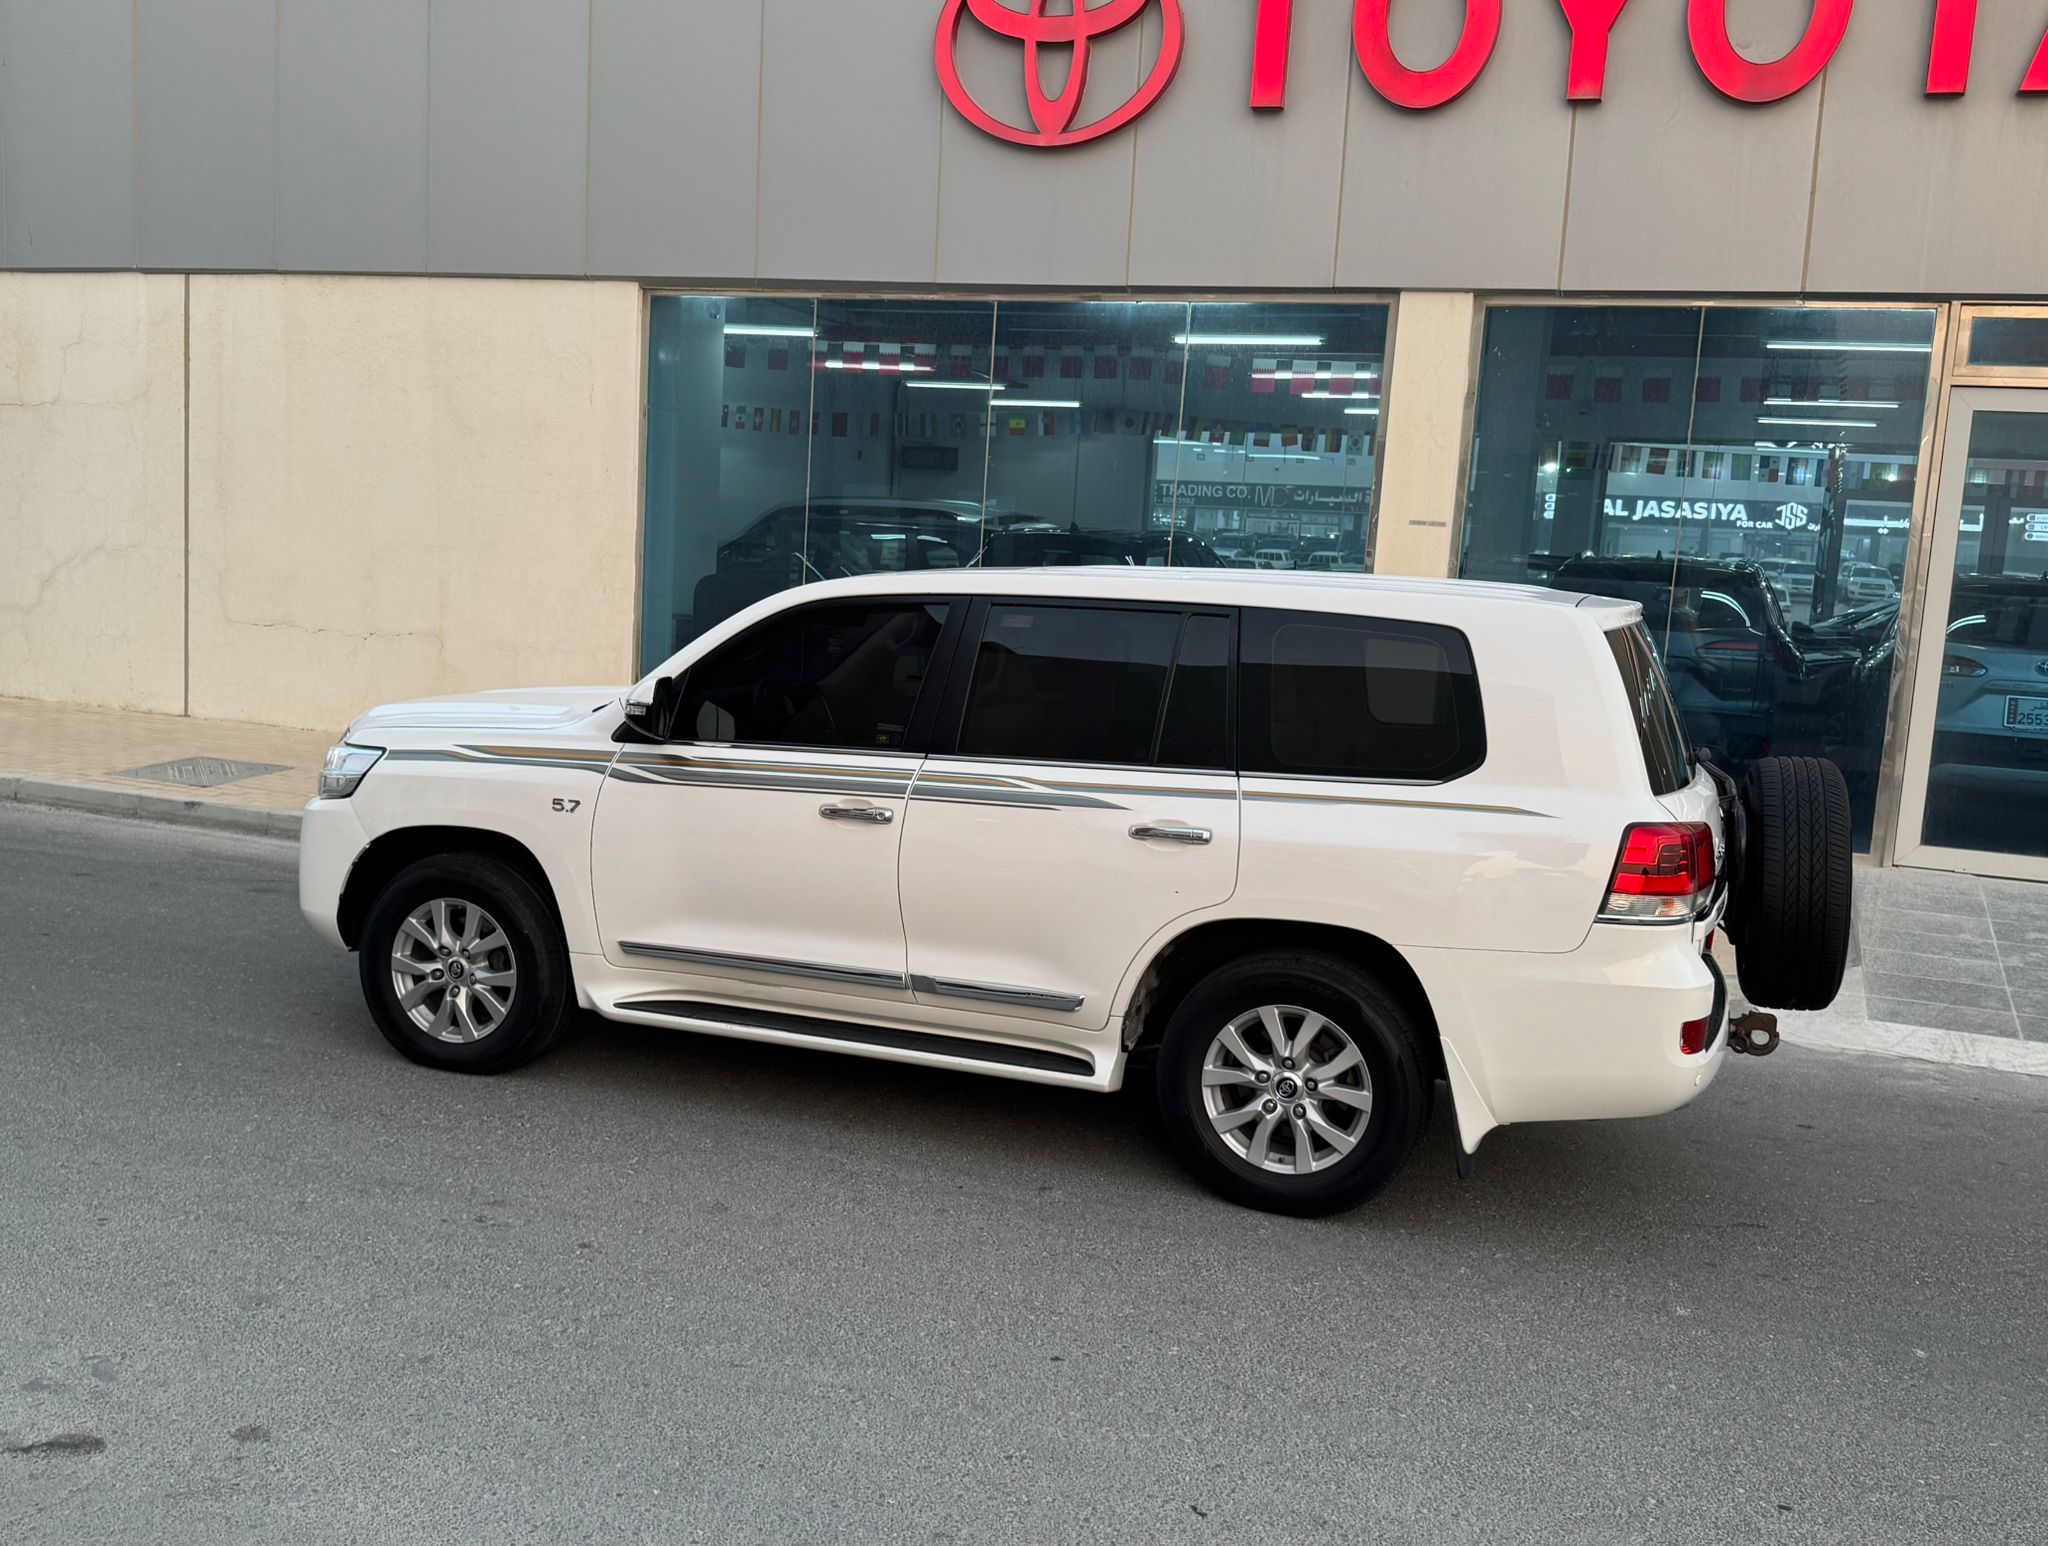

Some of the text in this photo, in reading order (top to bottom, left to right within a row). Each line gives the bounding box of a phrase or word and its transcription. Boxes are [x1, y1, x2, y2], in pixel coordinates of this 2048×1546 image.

[1249, 0, 2048, 110] OYO
[1603, 498, 1748, 521] AL JASASIYA
[1736, 520, 1774, 529] FOR CAR
[551, 798, 582, 814] 5.7
